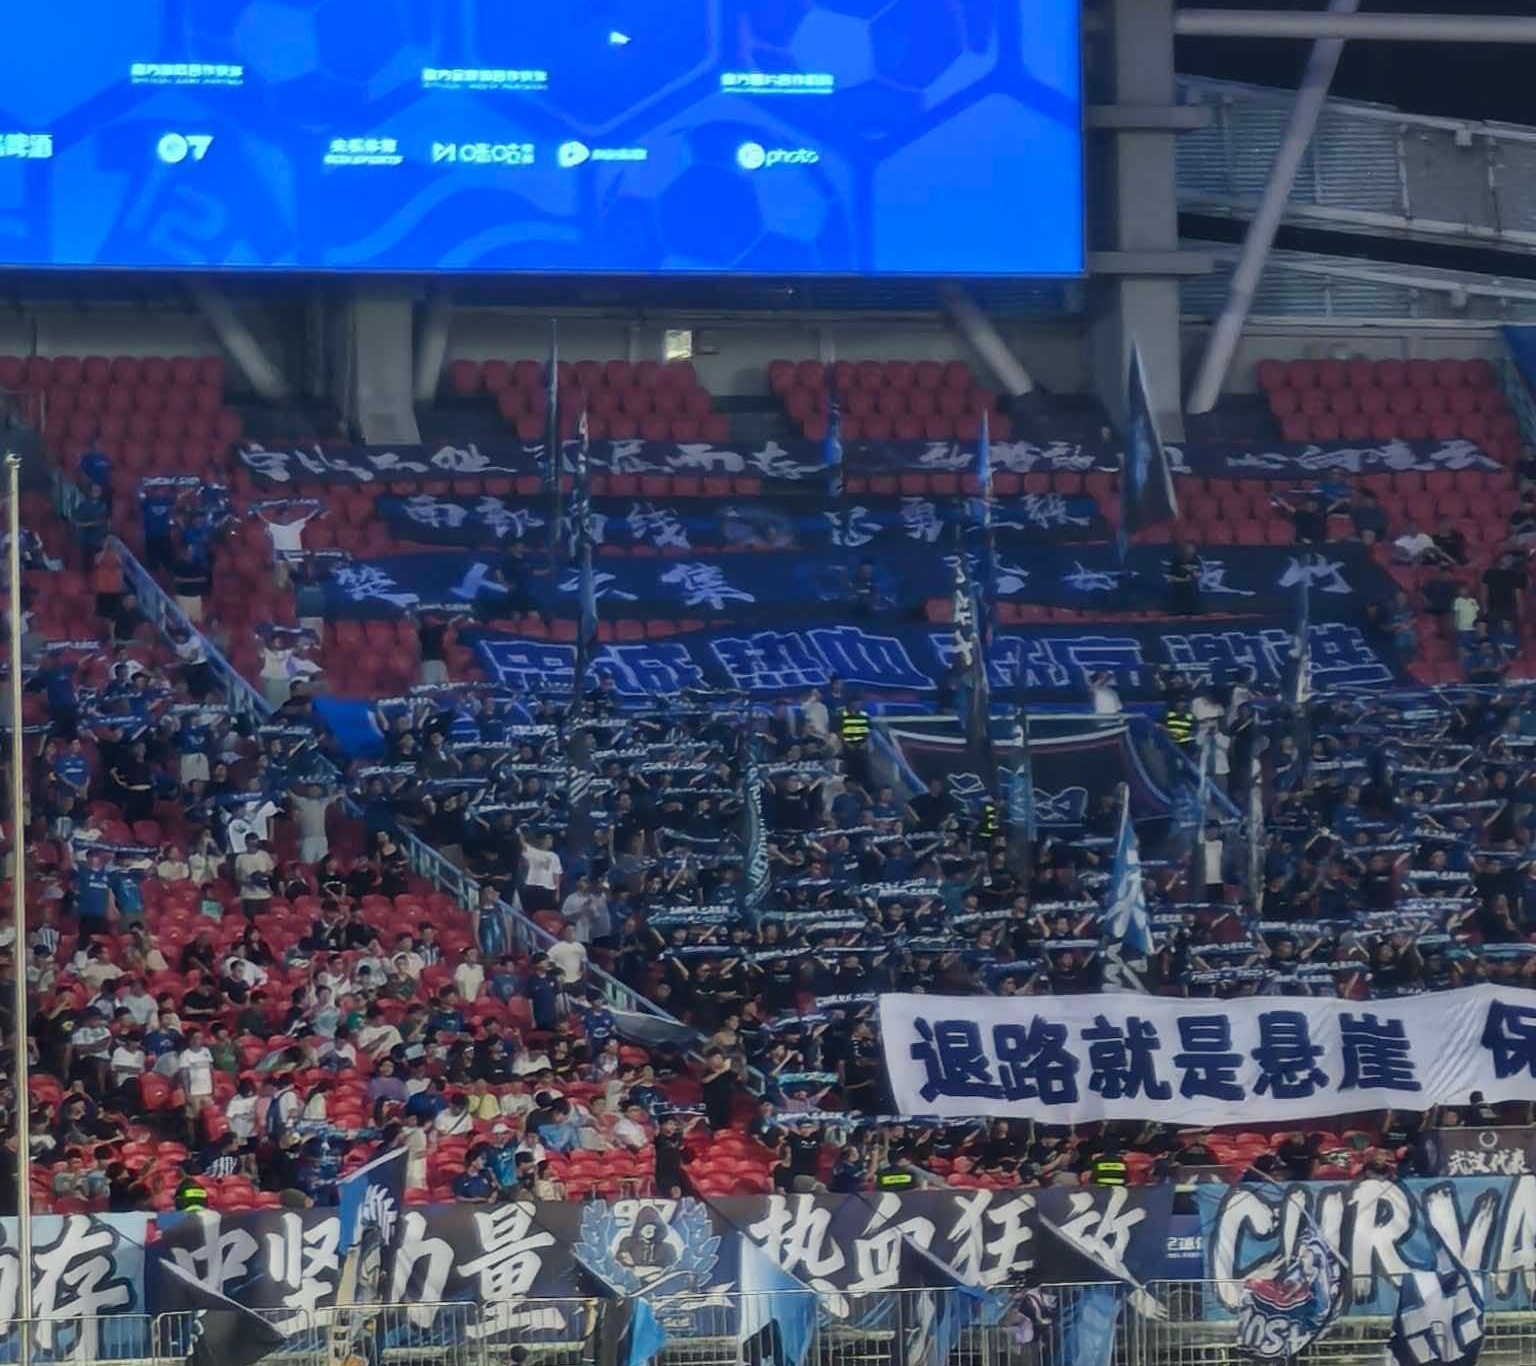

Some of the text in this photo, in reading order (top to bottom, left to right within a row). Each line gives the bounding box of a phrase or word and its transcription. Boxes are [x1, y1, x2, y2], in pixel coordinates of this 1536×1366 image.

[910, 1009, 1424, 1105] 退路就是悬崖
[0, 1212, 132, 1363] 存
